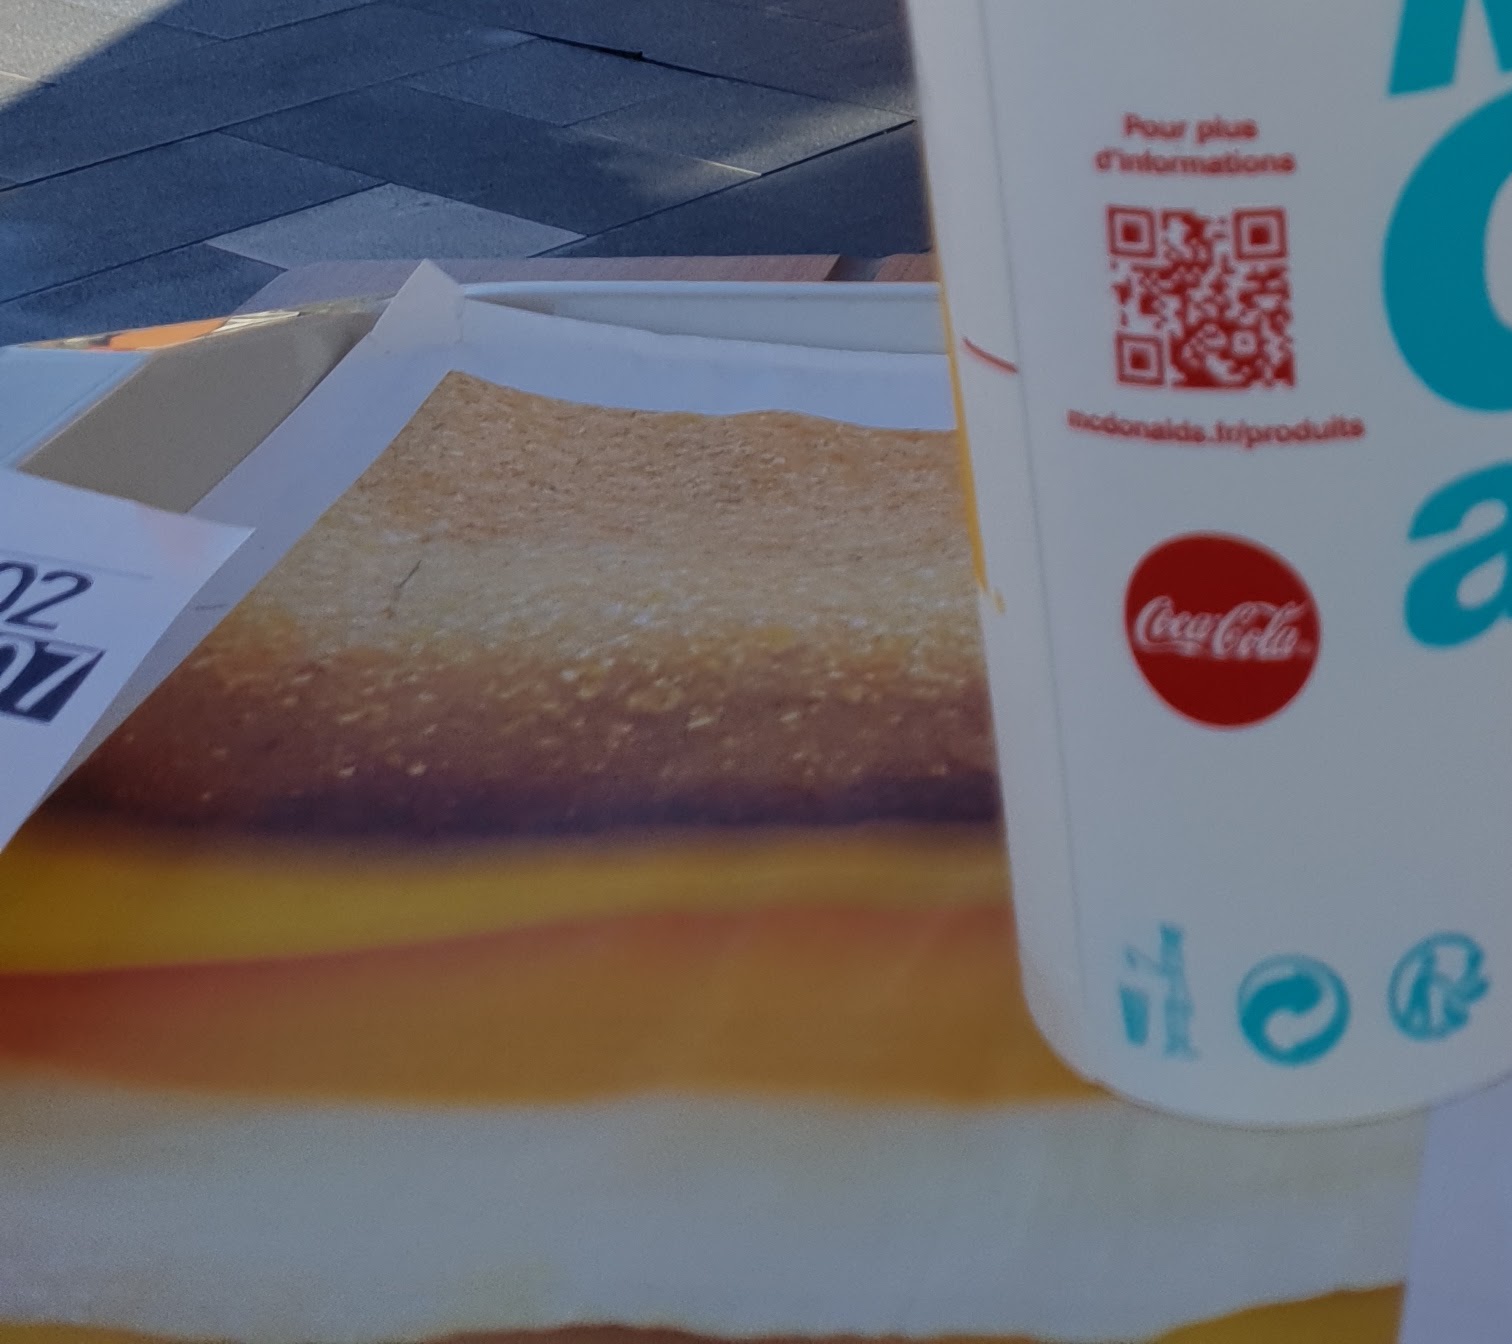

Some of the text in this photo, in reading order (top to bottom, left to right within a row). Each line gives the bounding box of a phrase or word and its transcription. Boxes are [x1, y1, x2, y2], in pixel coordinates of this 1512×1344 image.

[1121, 112, 1260, 146] Pour plus
[1096, 146, 1297, 176] d'informations
